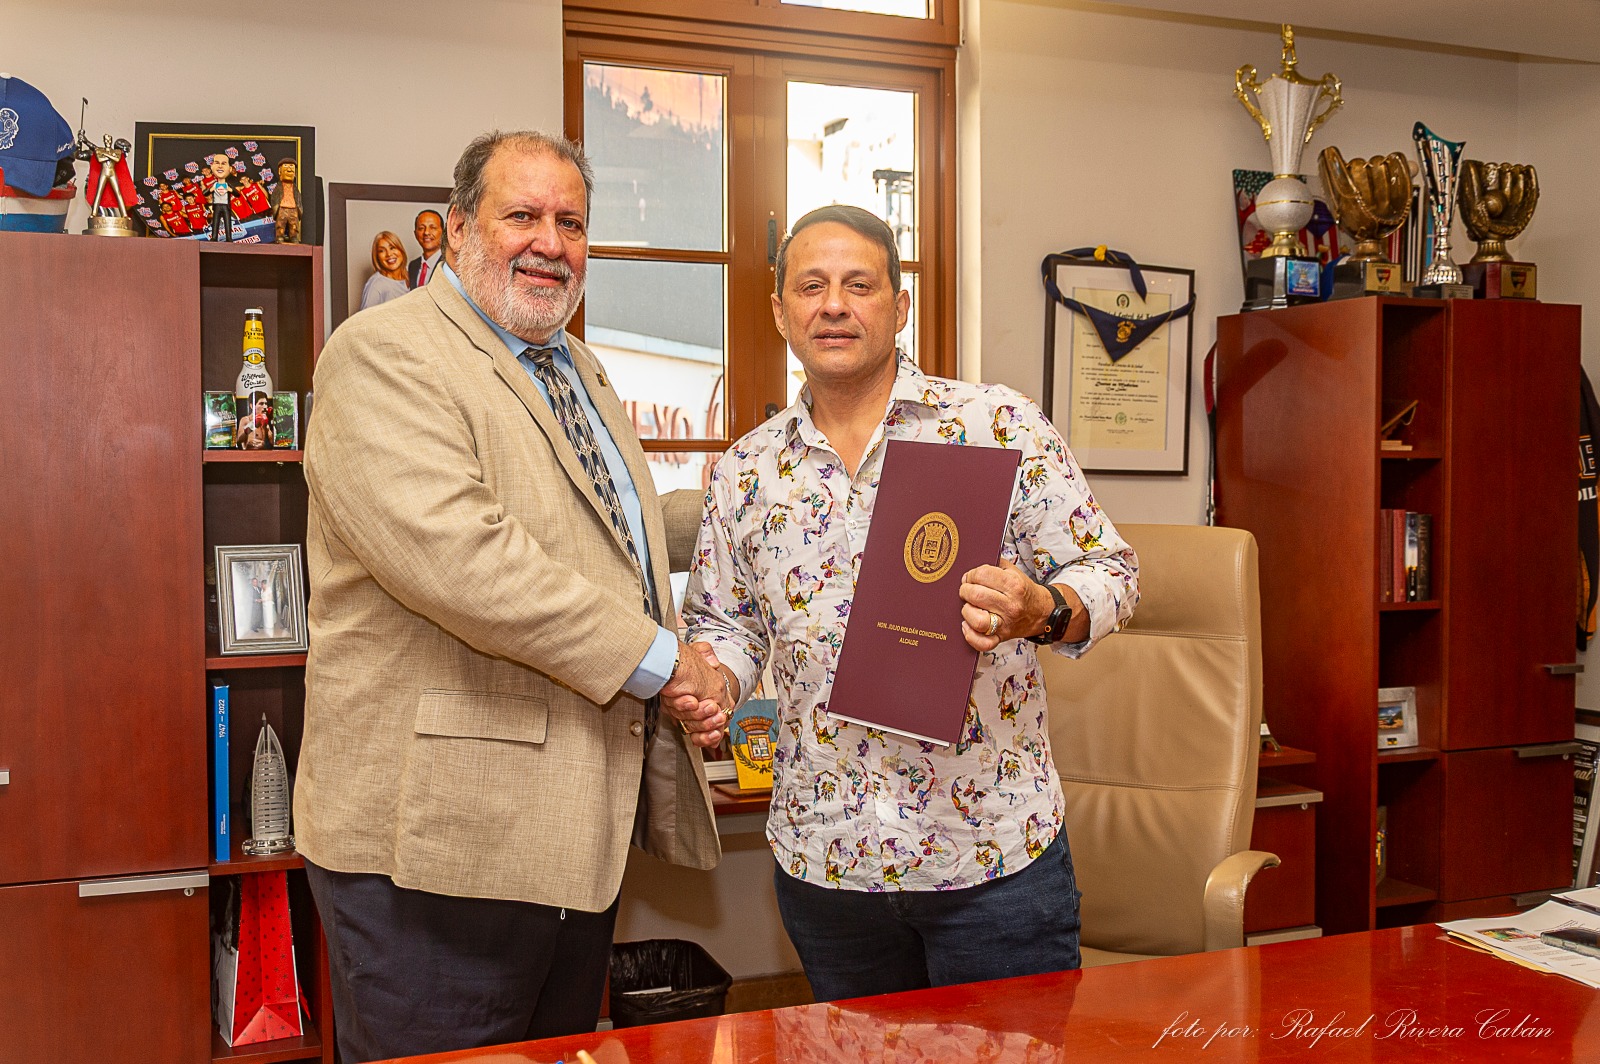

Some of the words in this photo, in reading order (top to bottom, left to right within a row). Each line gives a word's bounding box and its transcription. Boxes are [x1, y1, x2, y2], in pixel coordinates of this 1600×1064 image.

[918, 629, 948, 641] CONCEPCIÓN
[898, 637, 919, 647] ALCALDE
[218, 723, 226, 738] 1947
